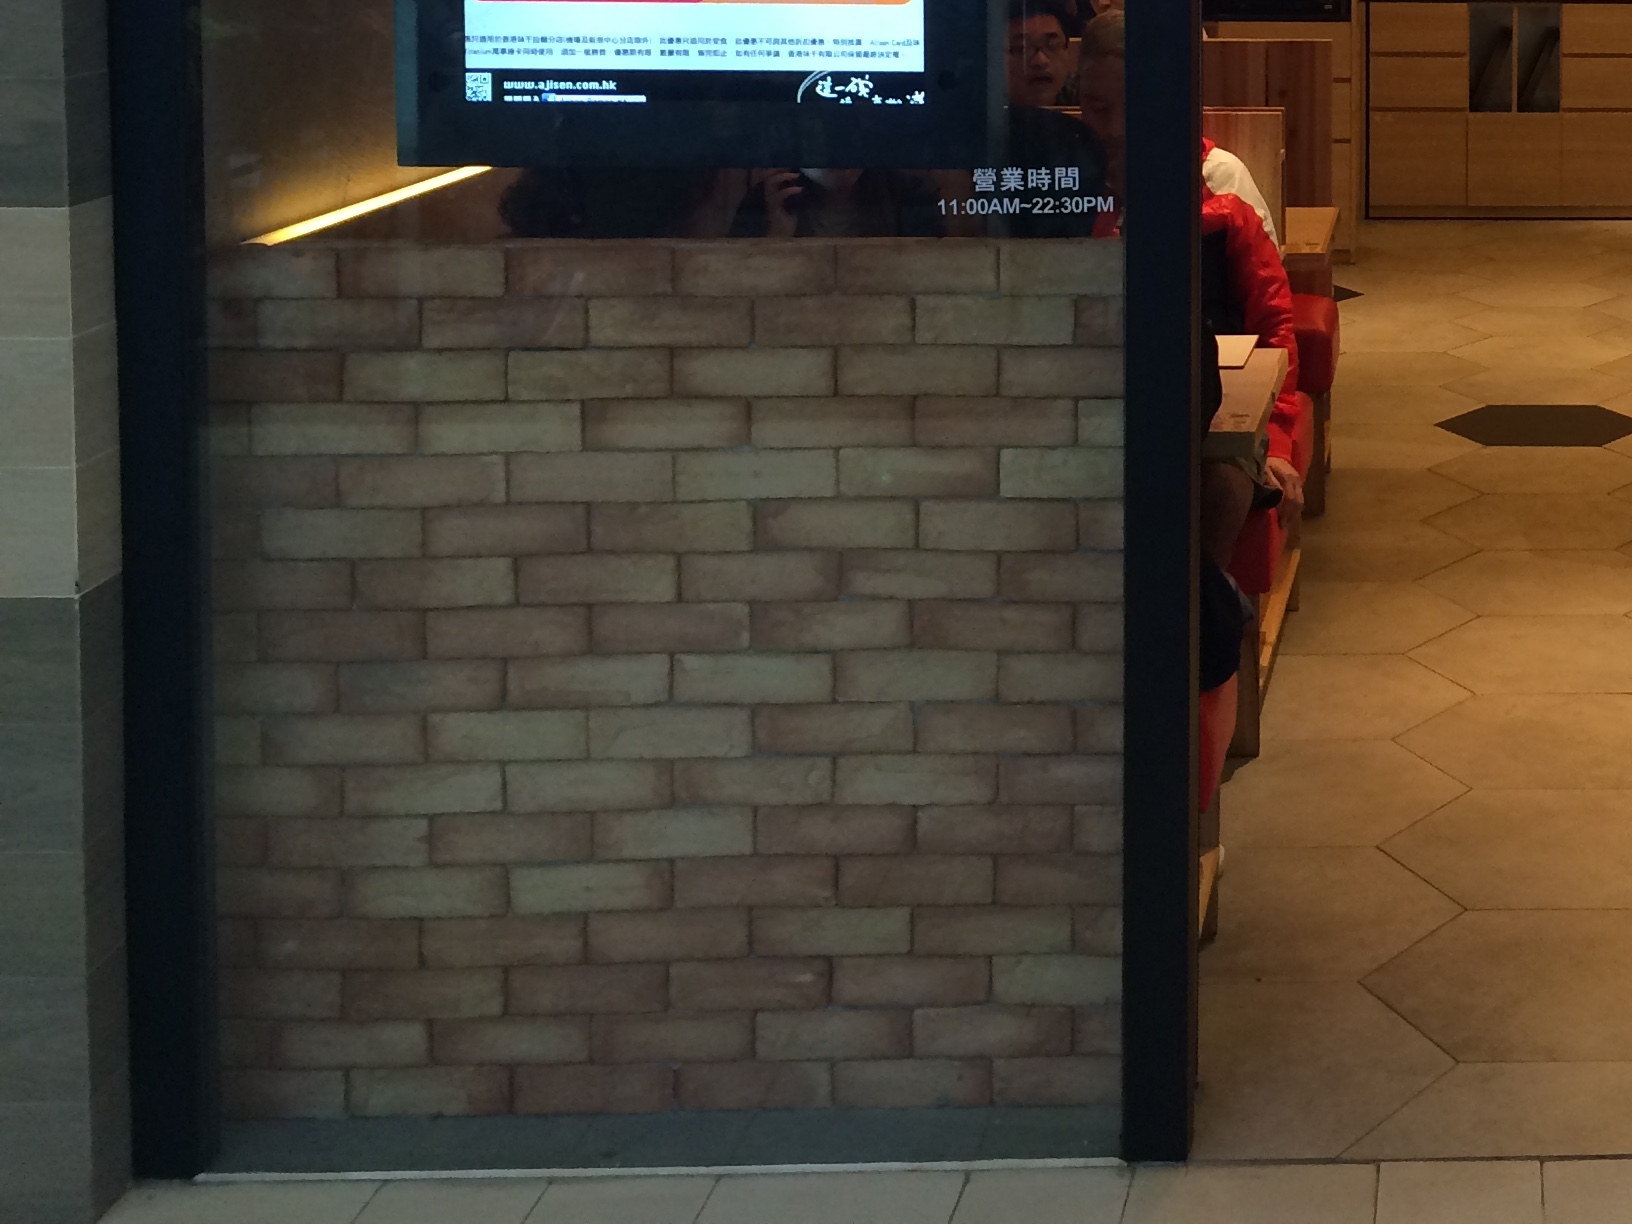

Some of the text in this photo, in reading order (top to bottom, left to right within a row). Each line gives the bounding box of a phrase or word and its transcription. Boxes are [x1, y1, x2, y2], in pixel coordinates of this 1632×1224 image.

[503, 80, 617, 92] www.ajisen.com.hk
[972, 167, 1080, 192] 營業時間
[937, 196, 1115, 216] 11:00AM~22:30PM
